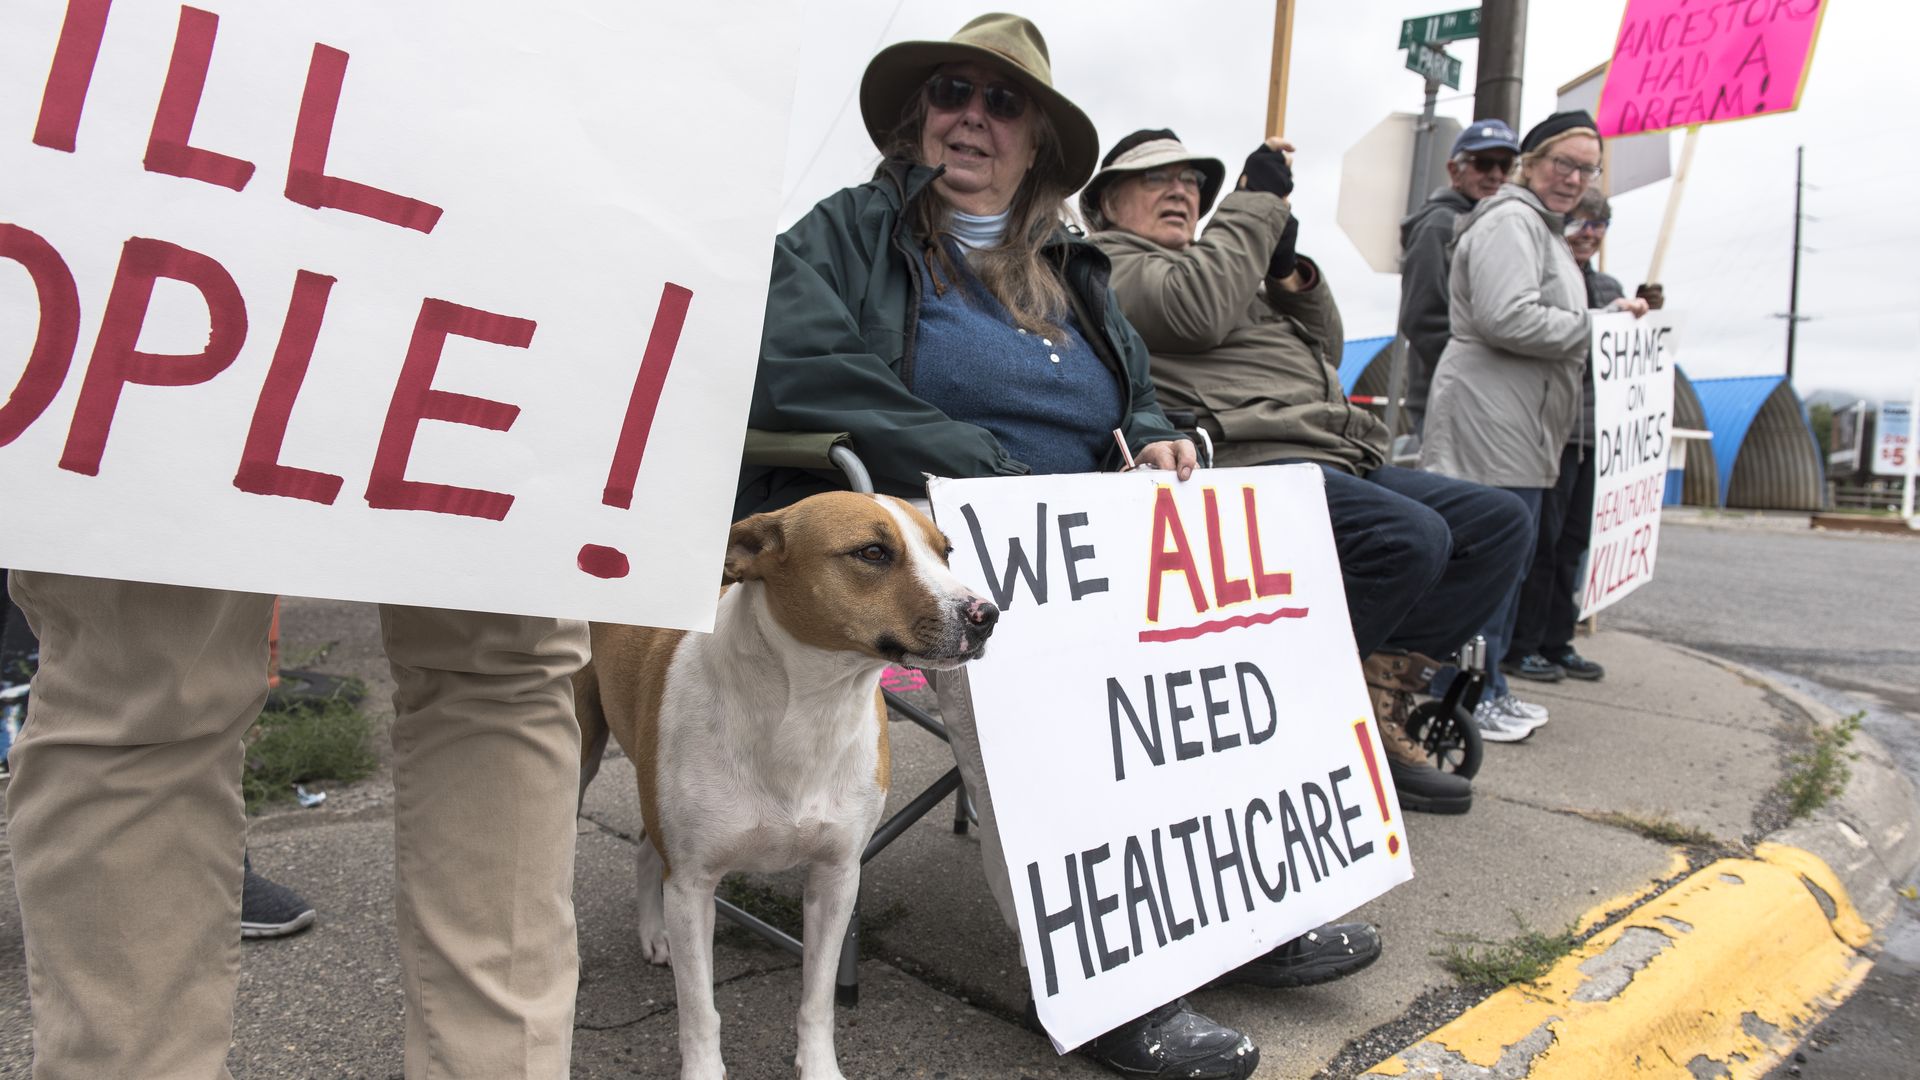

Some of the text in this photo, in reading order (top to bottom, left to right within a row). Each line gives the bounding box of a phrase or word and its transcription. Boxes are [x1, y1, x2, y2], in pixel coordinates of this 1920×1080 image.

[1418, 45, 1450, 82] PARK
[1613, 0, 1819, 62] ANCESTORS
[1637, 34, 1770, 94] HAD A
[1600, 327, 1672, 380] SHAME
[1627, 384, 1646, 411] ON
[1599, 412, 1666, 477] DAINES
[1594, 472, 1663, 537] HEALTHCARE
[960, 484, 1293, 623] WE ALL
[1584, 523, 1652, 611] KILLER
[1106, 662, 1277, 782] NEED
[1027, 718, 1400, 998] HEALTHCARE!
